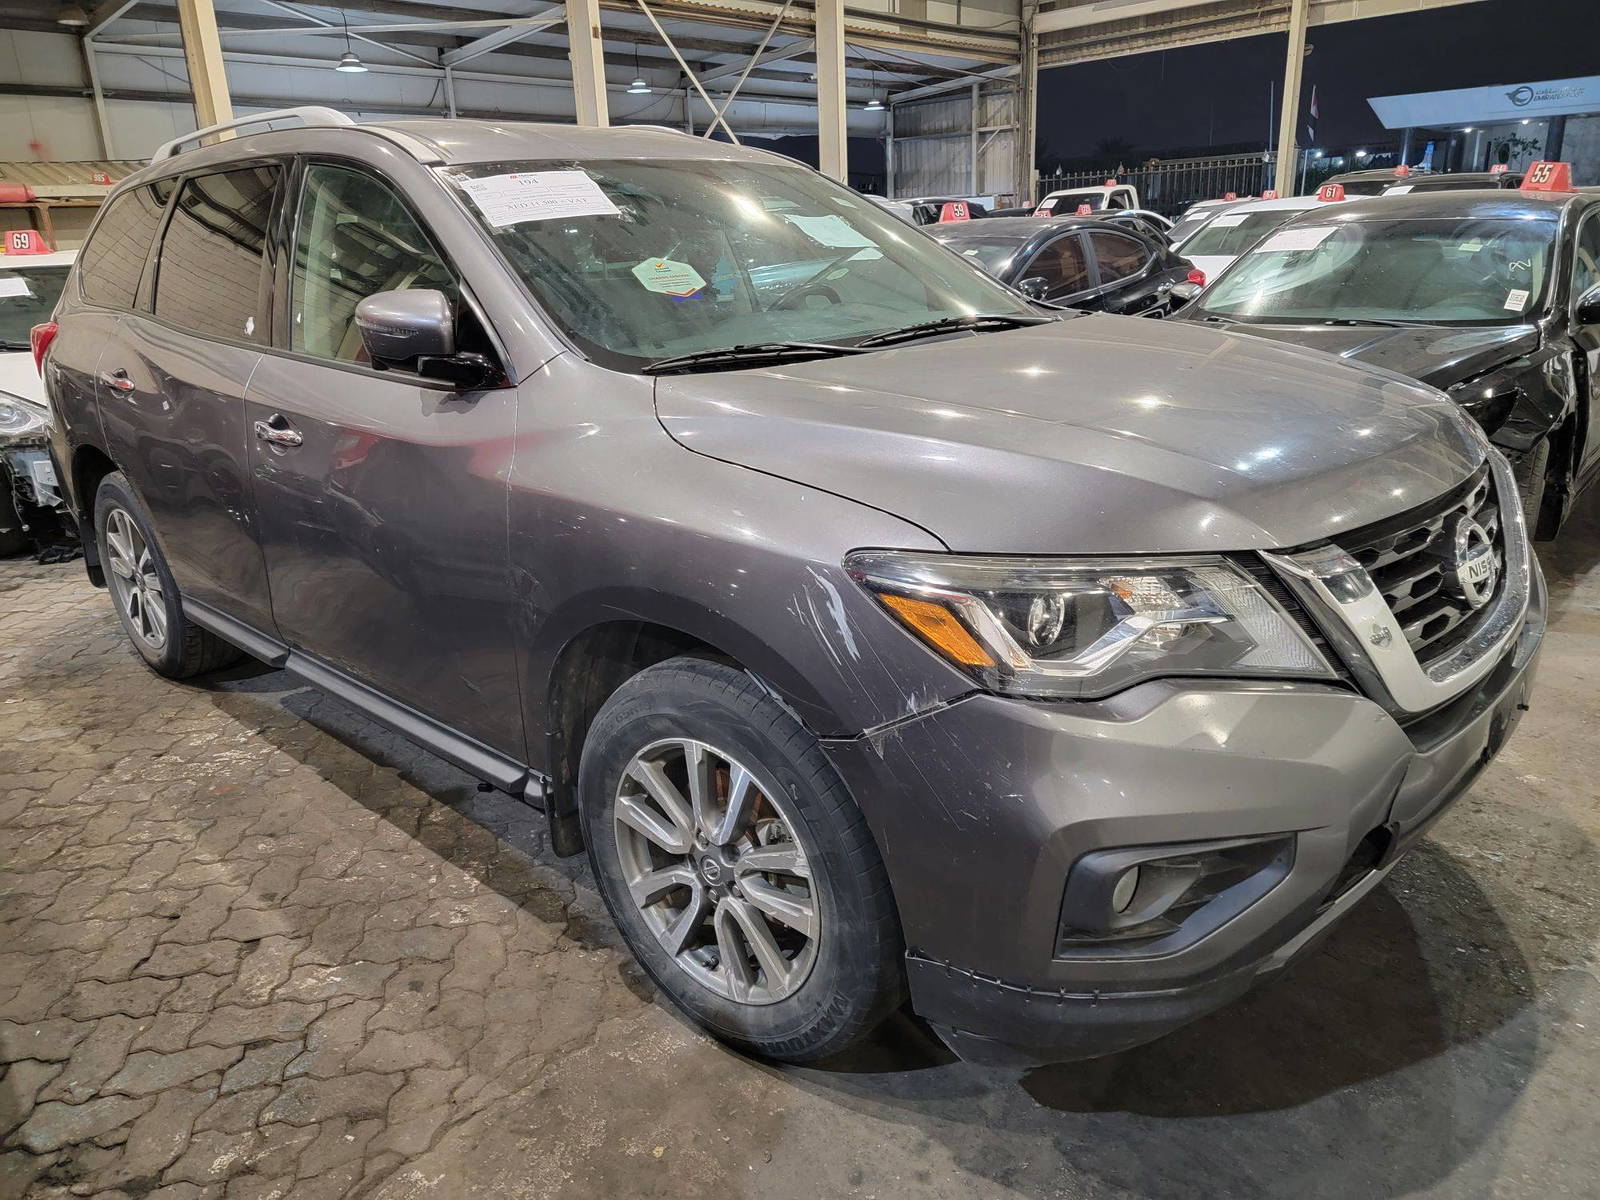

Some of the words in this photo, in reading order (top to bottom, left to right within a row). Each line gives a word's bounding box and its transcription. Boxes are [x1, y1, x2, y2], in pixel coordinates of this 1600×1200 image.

[1531, 163, 1554, 183] 55
[1325, 186, 1337, 199] 61
[953, 203, 966, 218] 59
[12, 232, 30, 249] 69
